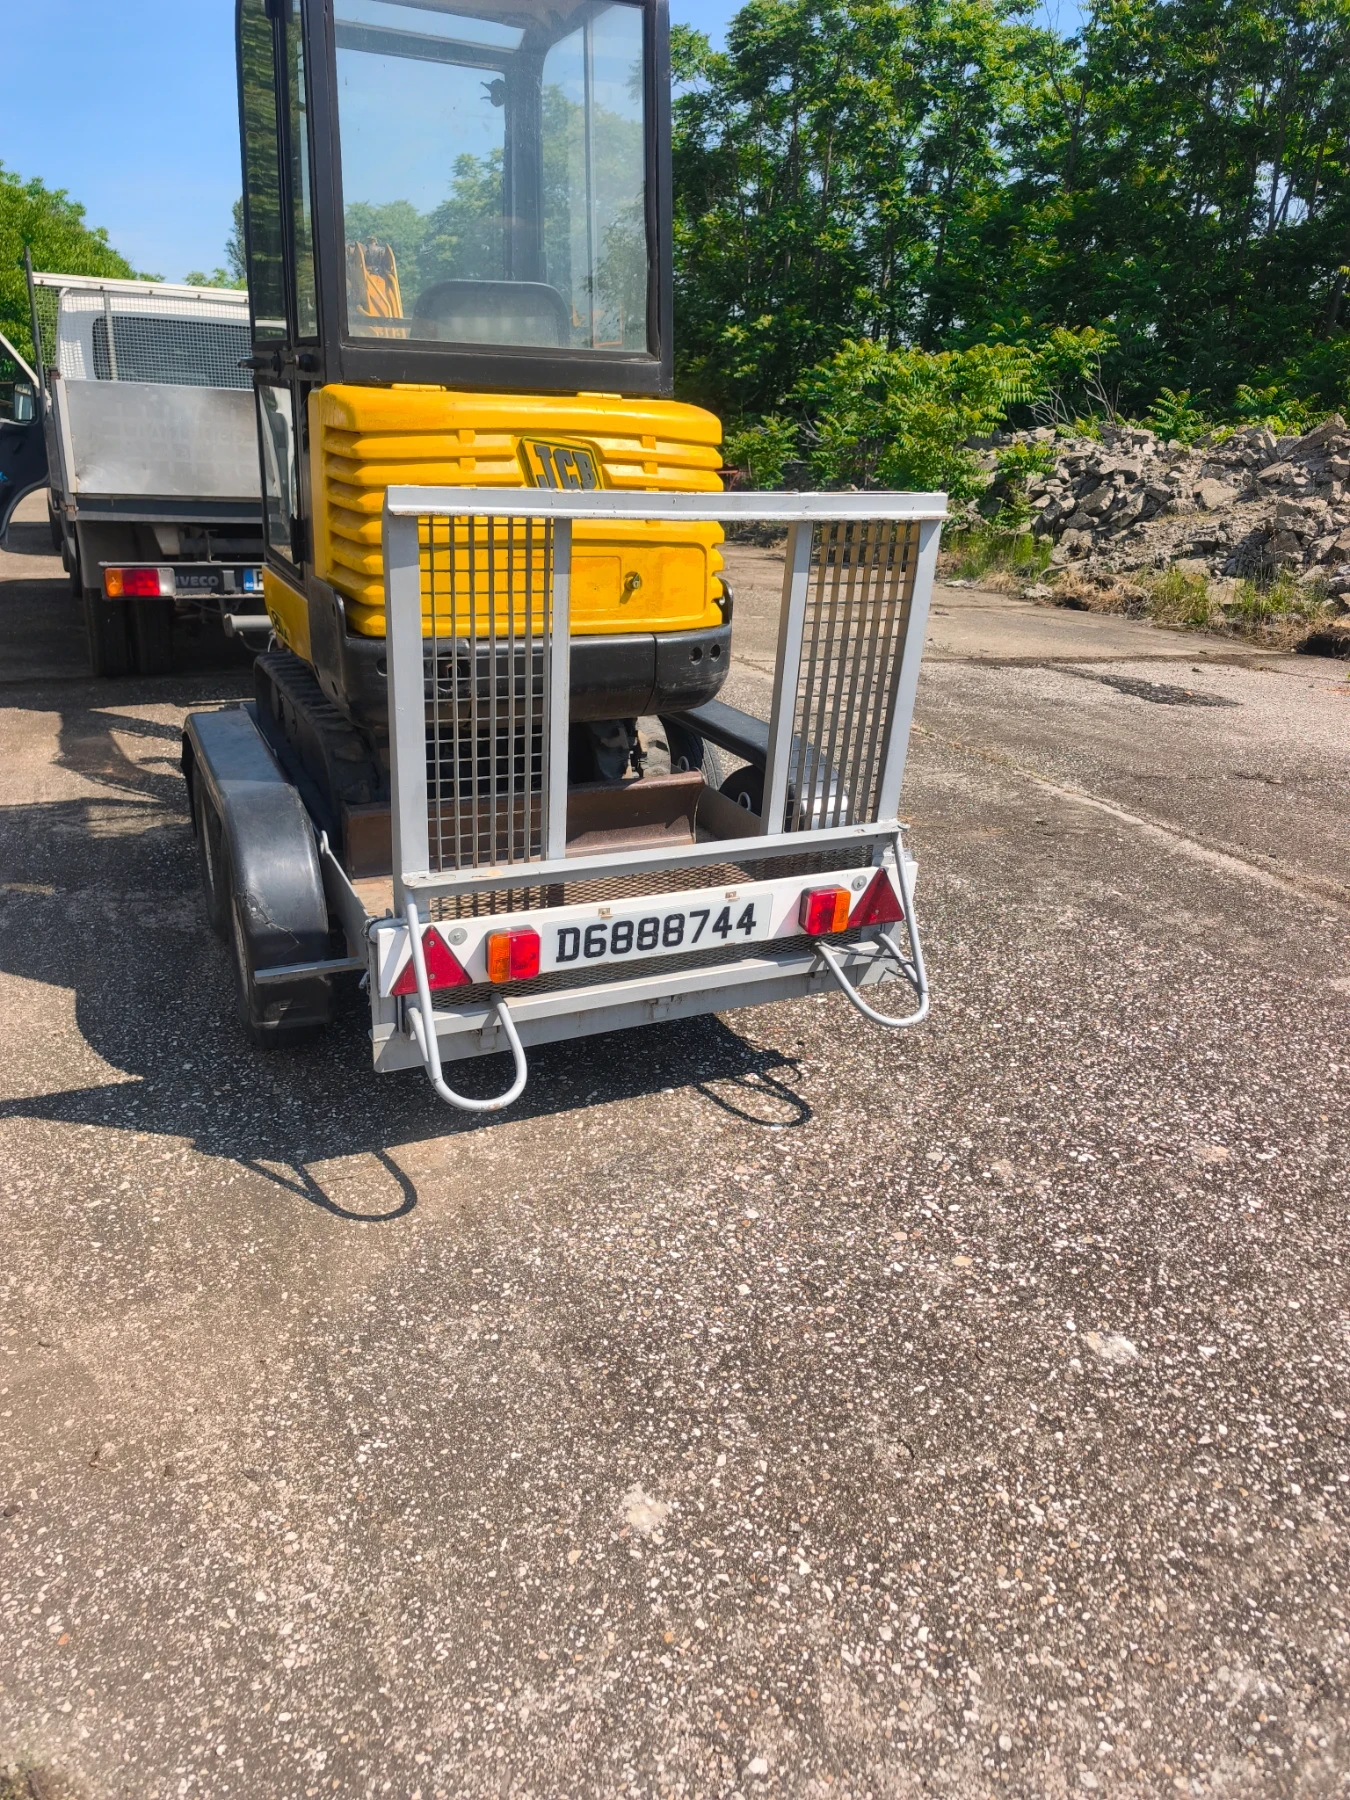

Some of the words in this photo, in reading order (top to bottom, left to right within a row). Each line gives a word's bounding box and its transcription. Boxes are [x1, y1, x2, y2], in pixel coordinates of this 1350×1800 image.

[533, 444, 597, 489] JCB
[175, 576, 219, 586] IVECO
[556, 902, 757, 963] D6888744
